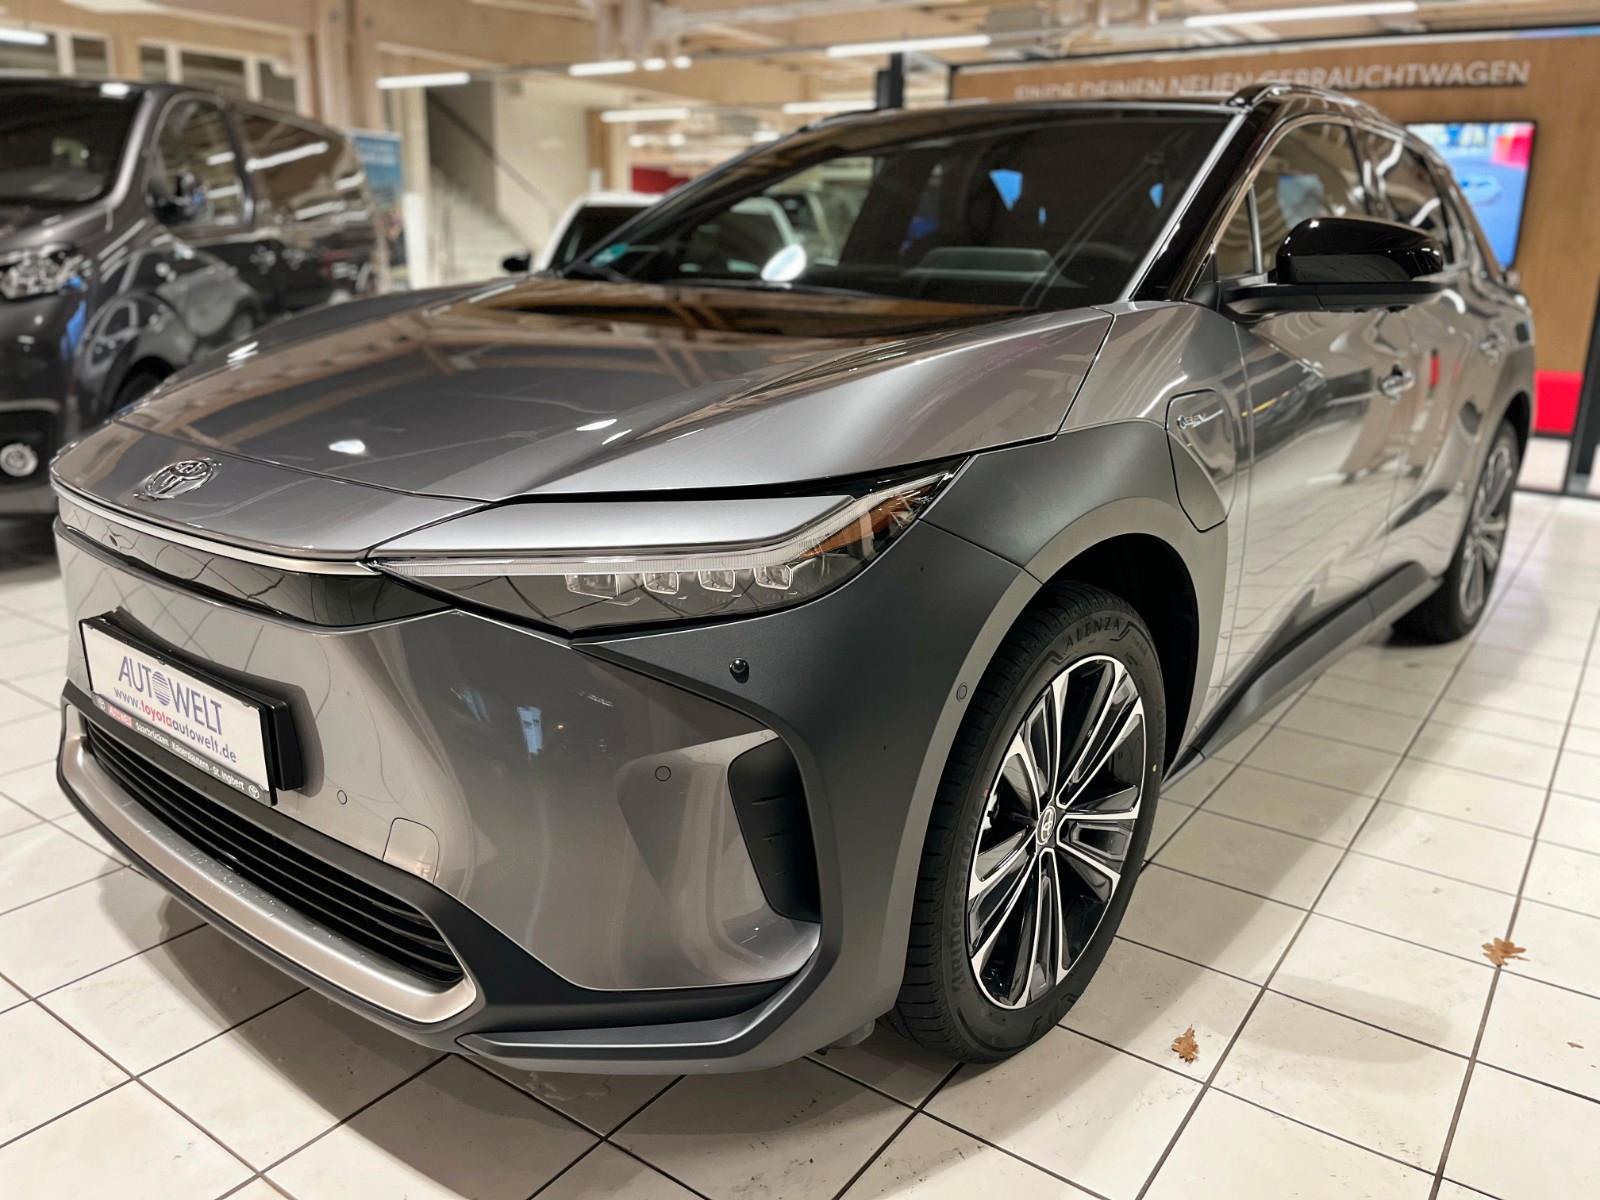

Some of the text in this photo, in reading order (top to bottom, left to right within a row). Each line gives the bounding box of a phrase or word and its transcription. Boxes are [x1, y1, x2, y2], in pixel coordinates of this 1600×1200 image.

[1259, 60, 1532, 92] GEBRAUCHTWAGEN
[1063, 616, 1122, 652] ALENZA
[118, 655, 222, 735] AUTOWELT
[114, 687, 237, 763] www.toyotaautowelt.de
